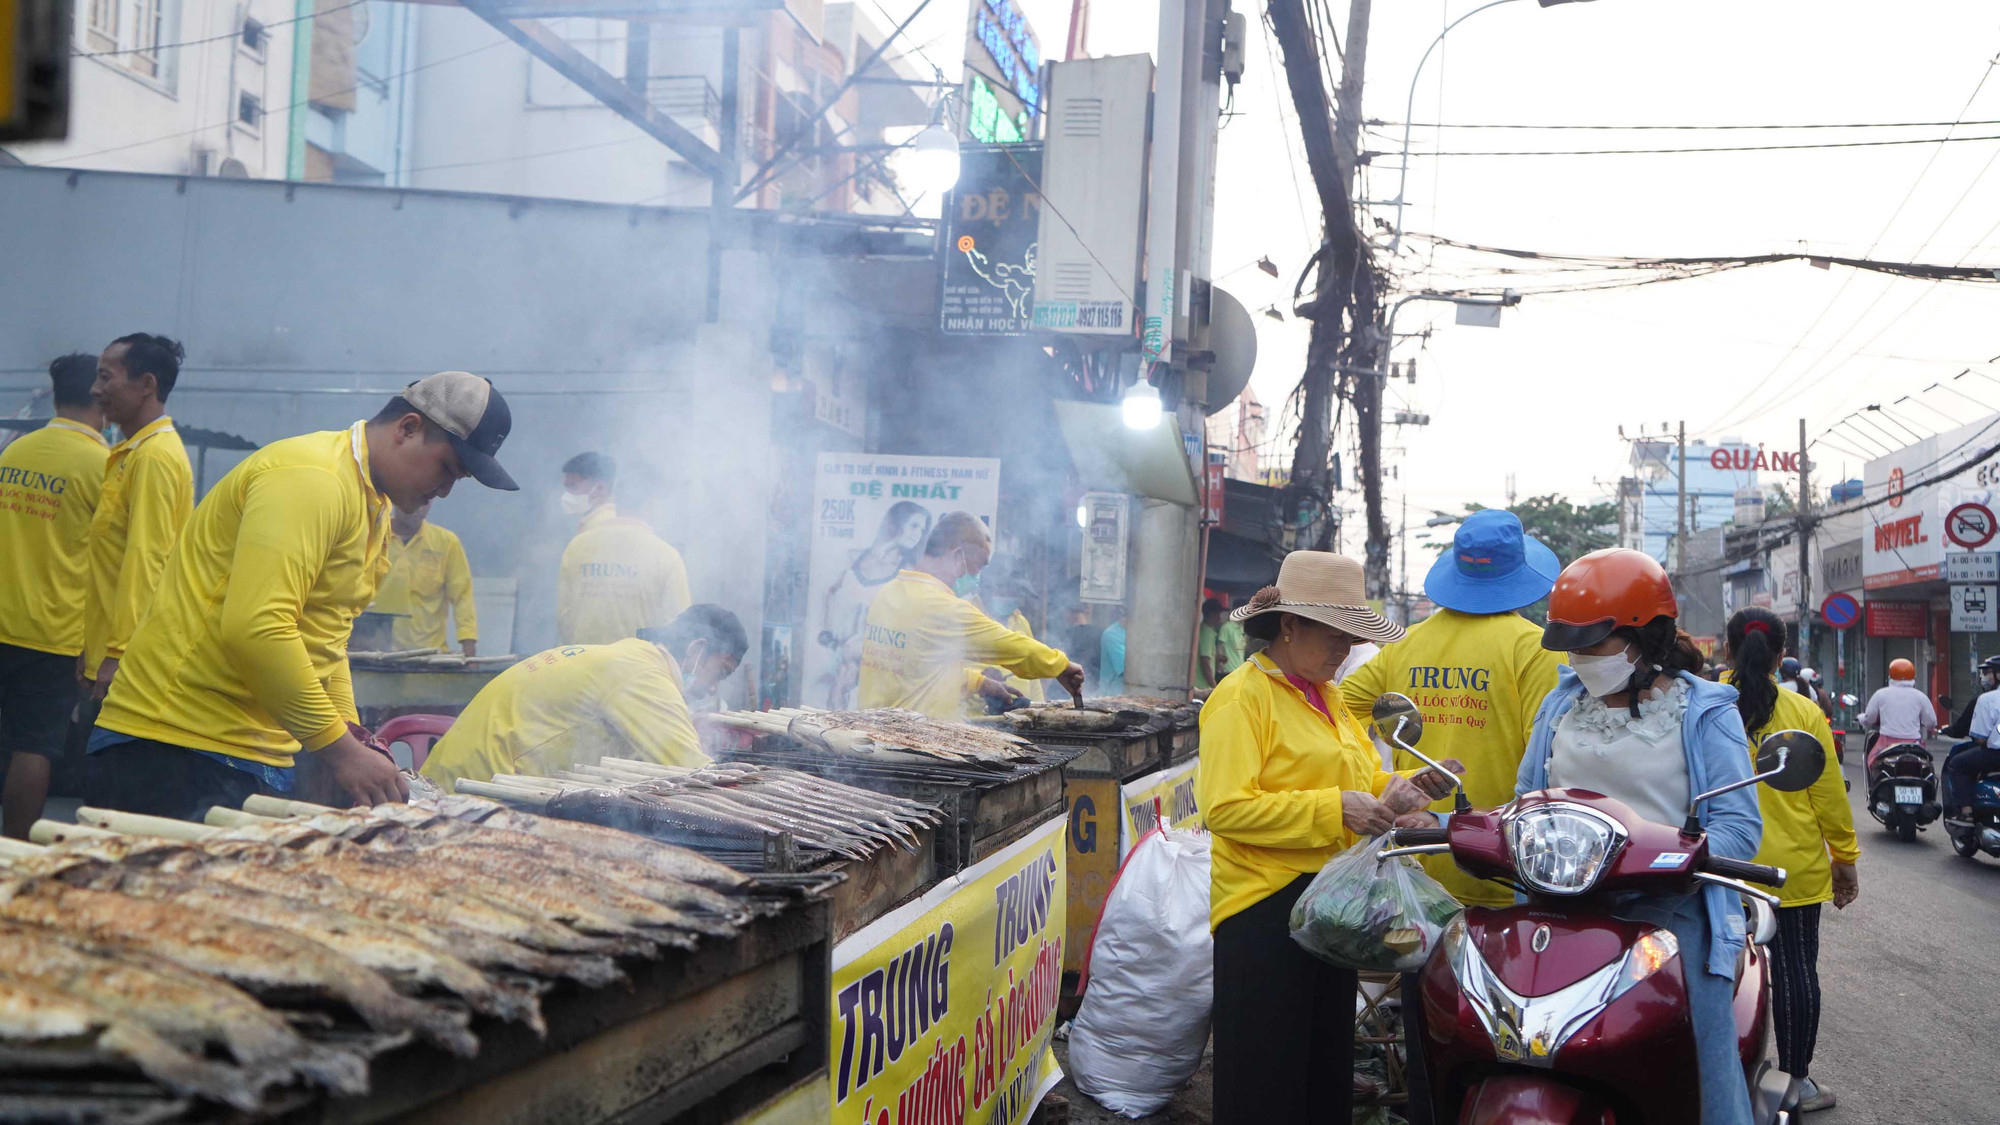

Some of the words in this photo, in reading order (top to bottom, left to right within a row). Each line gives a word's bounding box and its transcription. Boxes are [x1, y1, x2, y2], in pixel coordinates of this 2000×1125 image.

[0, 467, 66, 495] TRUNG
[901, 466, 907, 477] &
[910, 466, 948, 479] FITNESS
[850, 480, 883, 500] ĐỆ
[891, 480, 963, 500] NHẤT
[821, 499, 856, 521] 250K
[1409, 667, 1490, 692] TRUNG
[1423, 694, 1449, 708] LÓC
[1420, 713, 1435, 723] ân
[1466, 716, 1487, 729] Quý
[994, 848, 1057, 968] TRUNG
[1528, 911, 1567, 919] HONDA
[837, 921, 955, 1105] TRUNG
[973, 986, 995, 1110] CÁ
